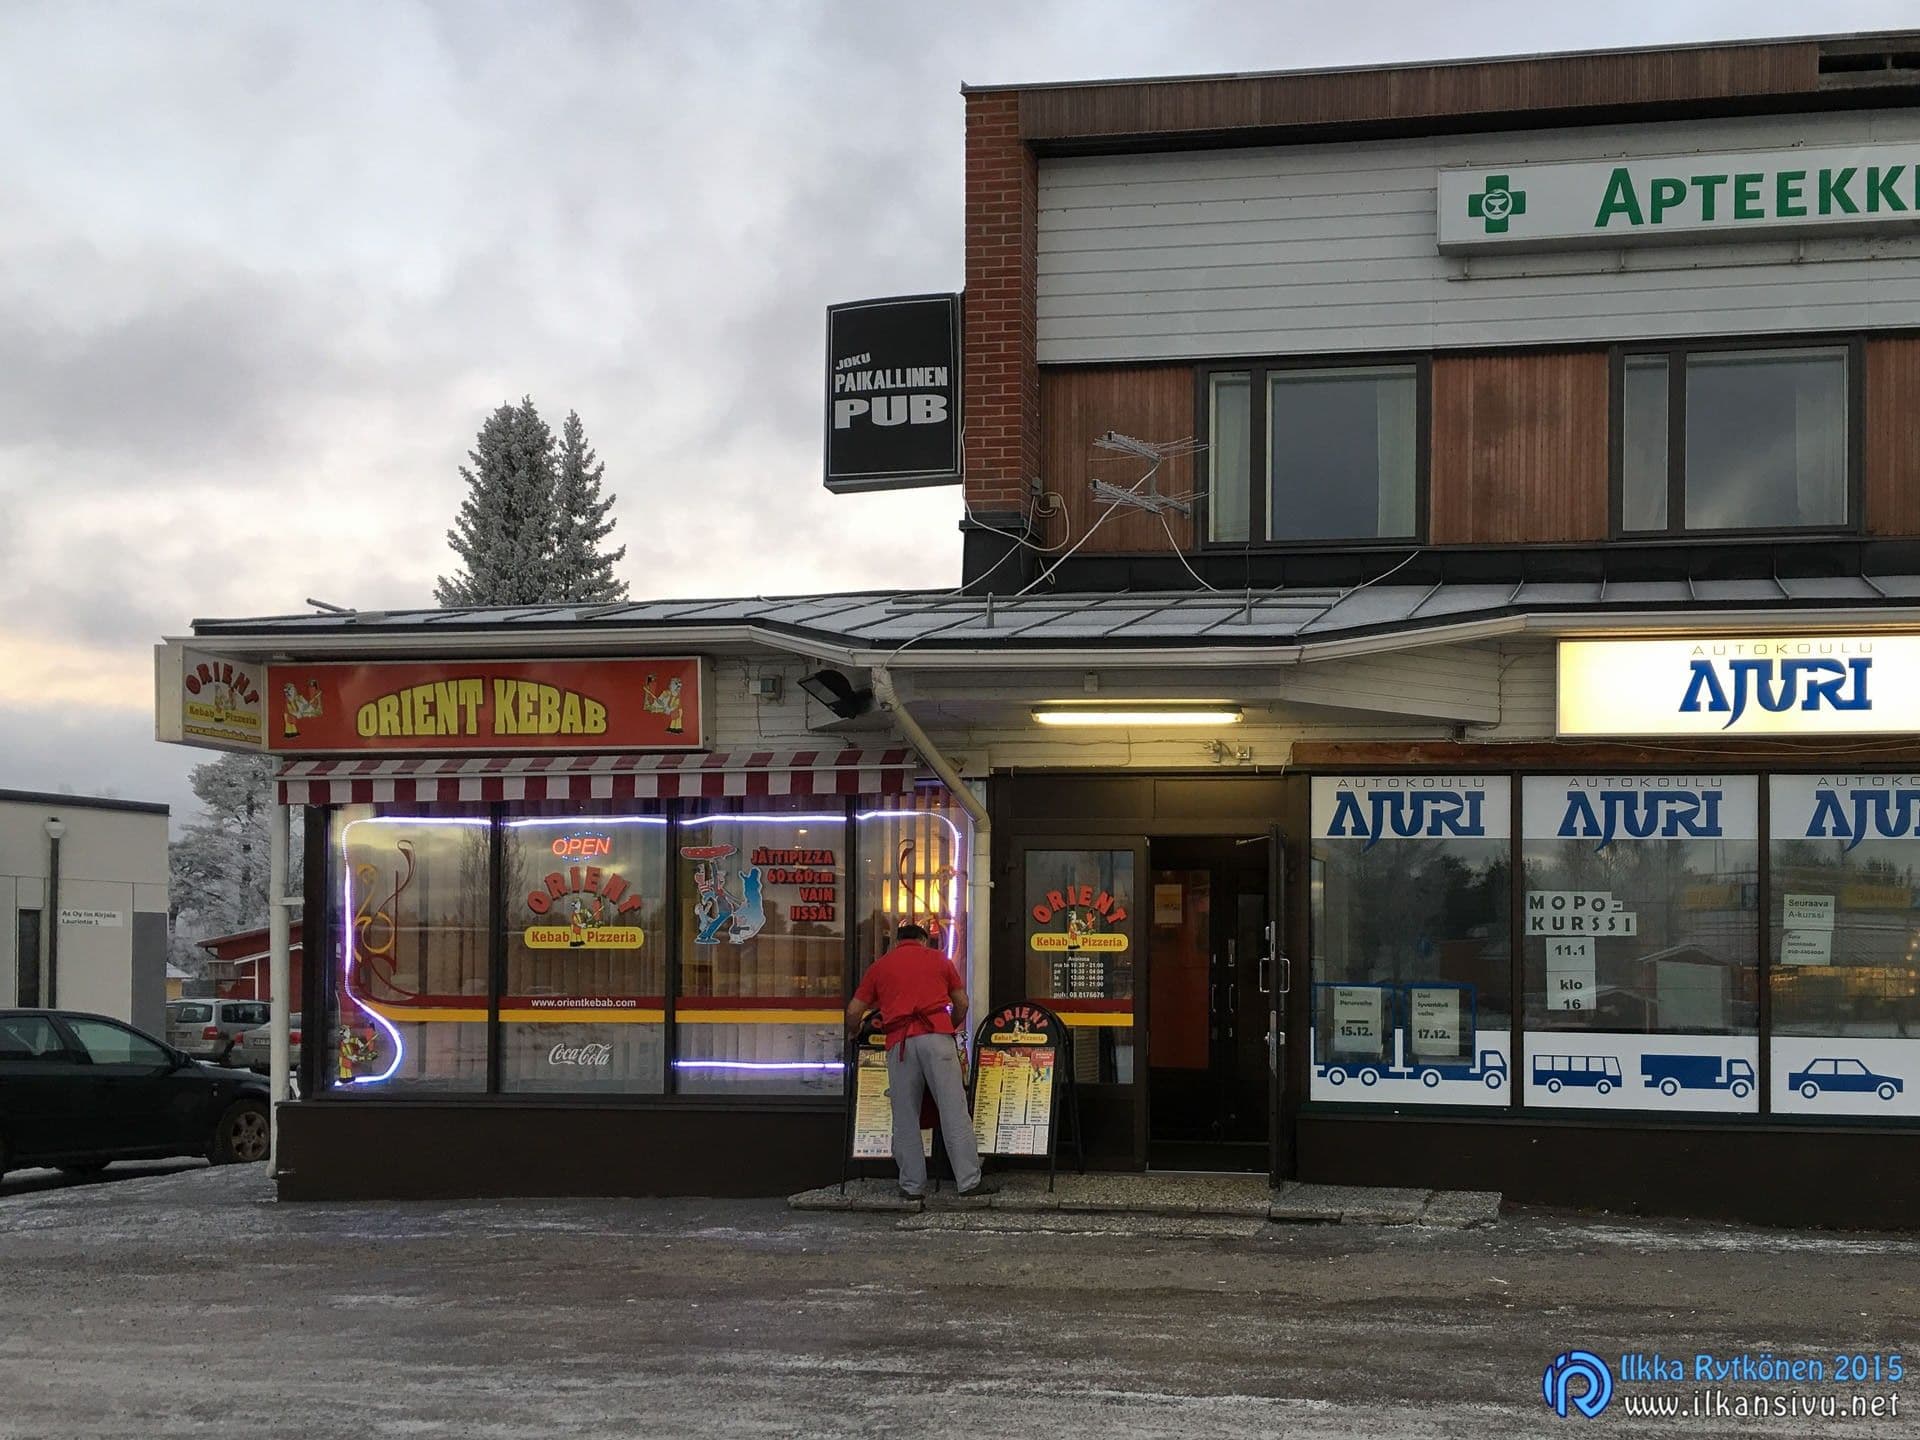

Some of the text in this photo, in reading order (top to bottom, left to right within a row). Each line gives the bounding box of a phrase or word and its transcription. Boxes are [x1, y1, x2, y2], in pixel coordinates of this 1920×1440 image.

[835, 352, 872, 370] JOKU
[835, 366, 948, 393] PAIKALLINEN
[834, 394, 948, 430] PUB
[1692, 643, 1872, 655] AUTOKOULU
[186, 661, 260, 705] ORIENT
[1678, 658, 1872, 730] AJURI
[357, 678, 607, 737] ORIENT KEBAB
[1337, 778, 1485, 788] AUTOKOULU
[1568, 778, 1722, 788] AUTOKOULU
[1326, 791, 1485, 853] AJURI
[1557, 791, 1723, 853] AJURI
[1805, 790, 1920, 853] AJU
[552, 837, 612, 856] OPEN
[751, 846, 835, 866] JÄTTIPIZZA
[767, 868, 835, 885] 60x60cm
[527, 866, 642, 914] ORIENT
[799, 887, 835, 903] VAIN
[790, 903, 835, 921] IISSÄ!
[1032, 884, 1128, 925] ORIENT
[1788, 899, 1829, 908] Seuraava
[1532, 916, 1630, 931] KURSSI
[1788, 911, 1825, 919] A-kurssi
[531, 931, 637, 943] Kebab Pizzeria
[1036, 936, 1123, 947] Kebab Pizzeria
[1555, 944, 1585, 956] 11.1
[1560, 979, 1583, 990] klo
[531, 998, 637, 1008] www.orientkebab.com
[1563, 999, 1581, 1010] 16
[994, 1007, 1049, 1029] ORIENT
[1340, 1026, 1373, 1037] 15.12.
[1417, 1029, 1450, 1039] 17.12.
[548, 1043, 614, 1066] Coca-Cola
